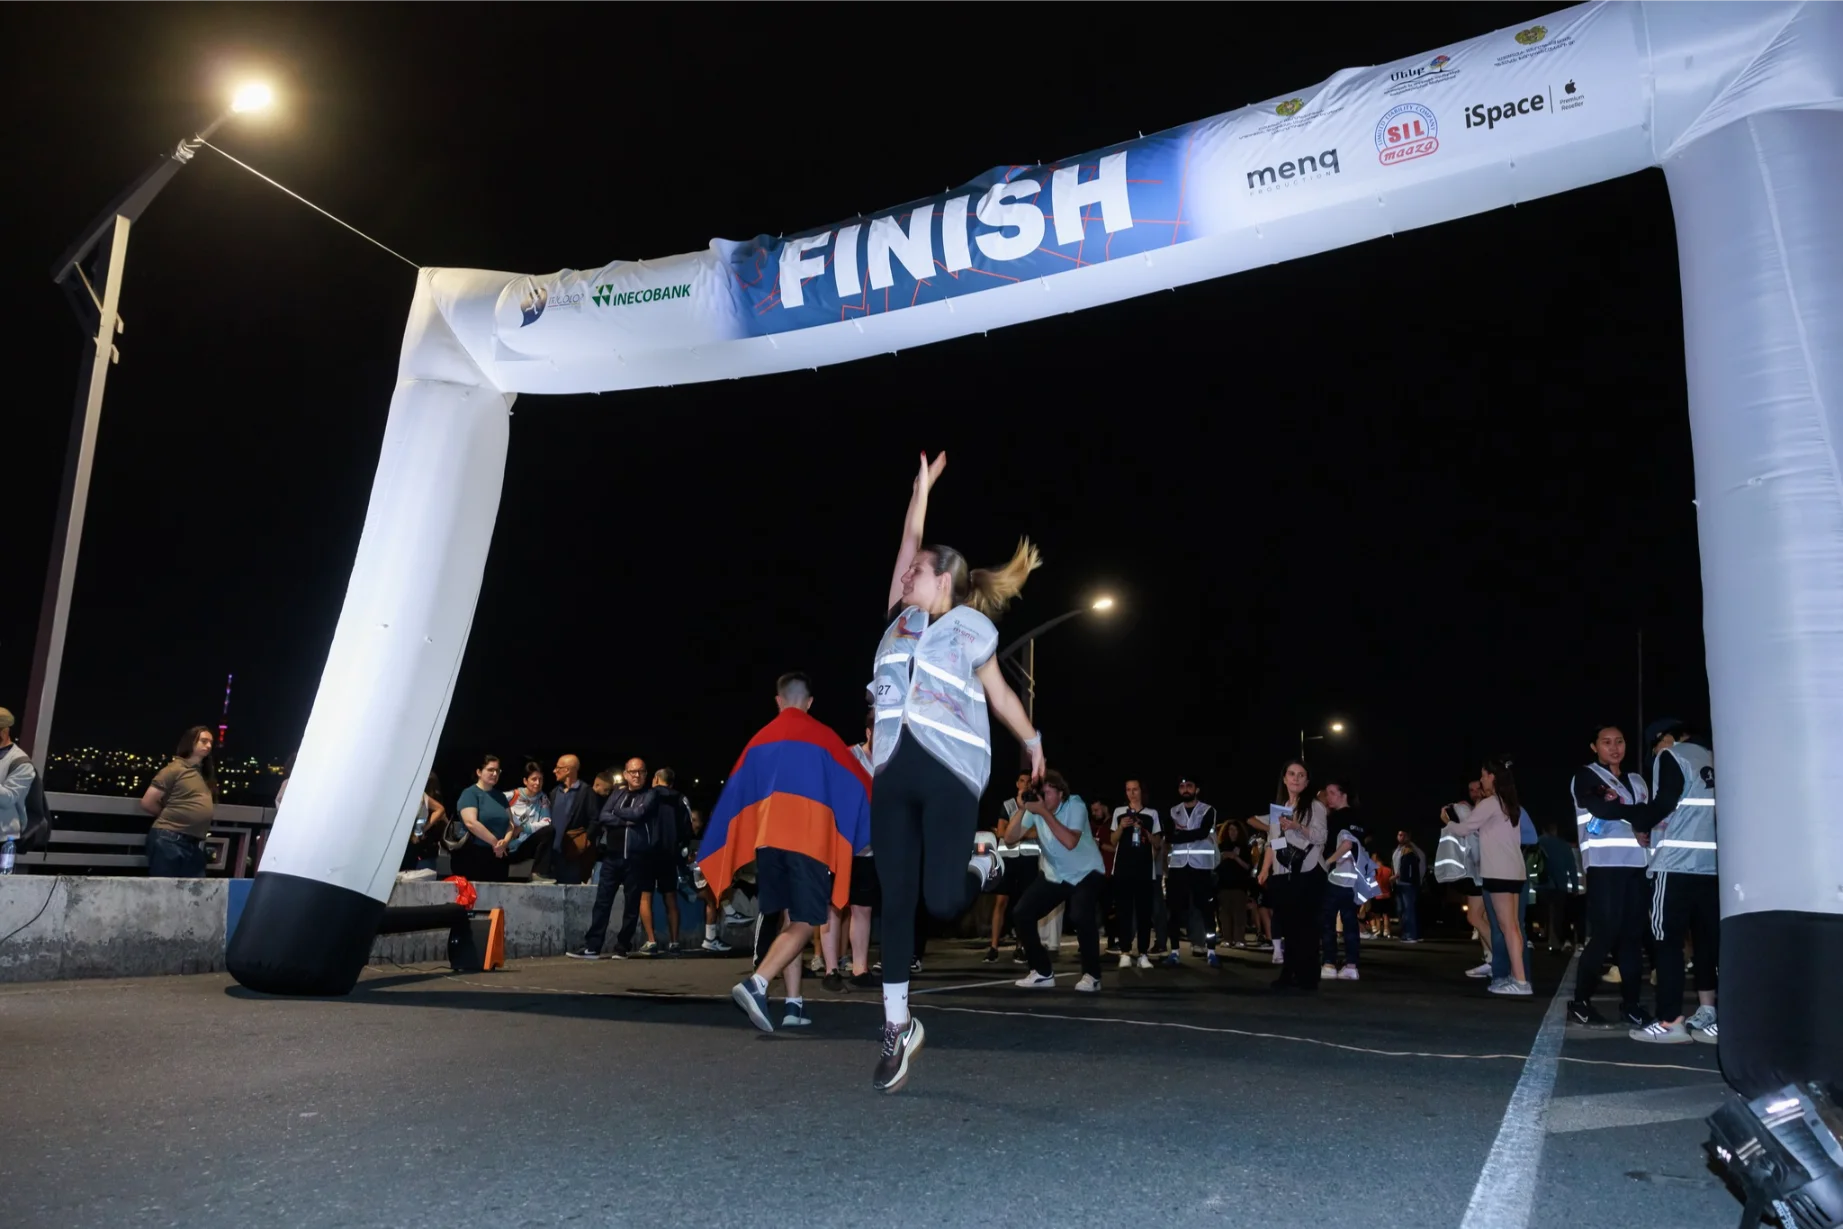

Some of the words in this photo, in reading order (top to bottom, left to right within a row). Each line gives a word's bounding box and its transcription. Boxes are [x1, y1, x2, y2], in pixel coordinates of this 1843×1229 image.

[1559, 94, 1585, 105] Premium
[1561, 100, 1584, 111] Reseller
[1465, 94, 1544, 130] iSpace
[1377, 121, 1386, 146] LIMITED
[1385, 105, 1413, 120] LIABILITY
[1415, 106, 1436, 131] COMPANY
[1387, 119, 1425, 143] SIL
[1384, 141, 1434, 161] maaza
[1247, 148, 1340, 189] menq
[1250, 171, 1331, 197] PRODUCTION
[779, 150, 1134, 309] FINISH
[613, 284, 691, 306] INECOBANK
[877, 684, 891, 695] 27
